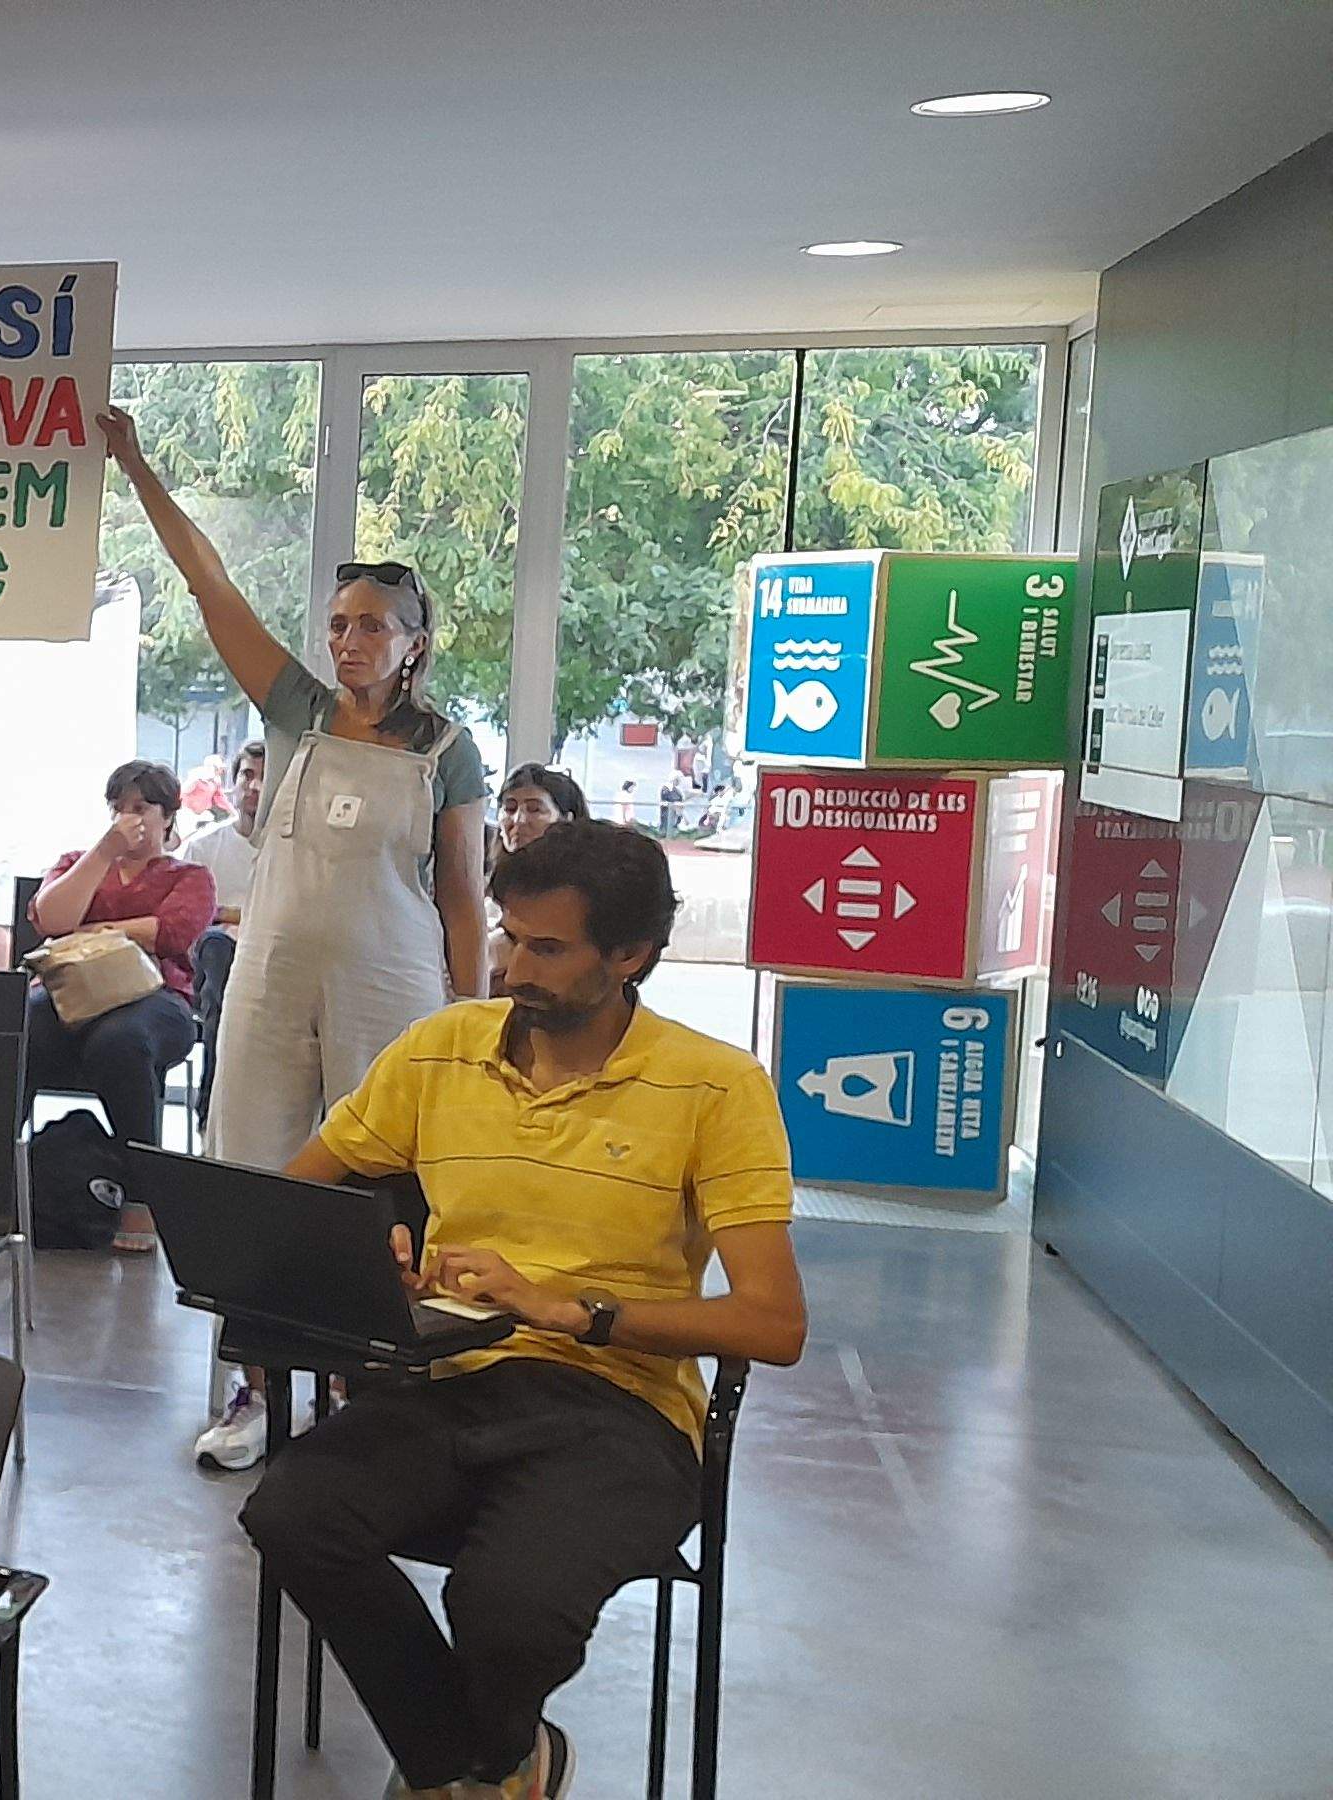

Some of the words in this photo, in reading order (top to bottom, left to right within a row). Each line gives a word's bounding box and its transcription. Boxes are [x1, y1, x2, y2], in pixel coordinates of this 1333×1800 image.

[759, 577, 783, 618] 14
[1025, 574, 1065, 598] 3
[1039, 607, 1060, 657] SALUT
[1015, 620, 1038, 703] BENESTAR
[770, 787, 811, 828] 10
[813, 787, 900, 809] REDUCCIÓ
[907, 792, 930, 811] DE
[937, 793, 966, 812] LES
[813, 809, 938, 832] DESIGUALTATS
[942, 1007, 989, 1031] 6
